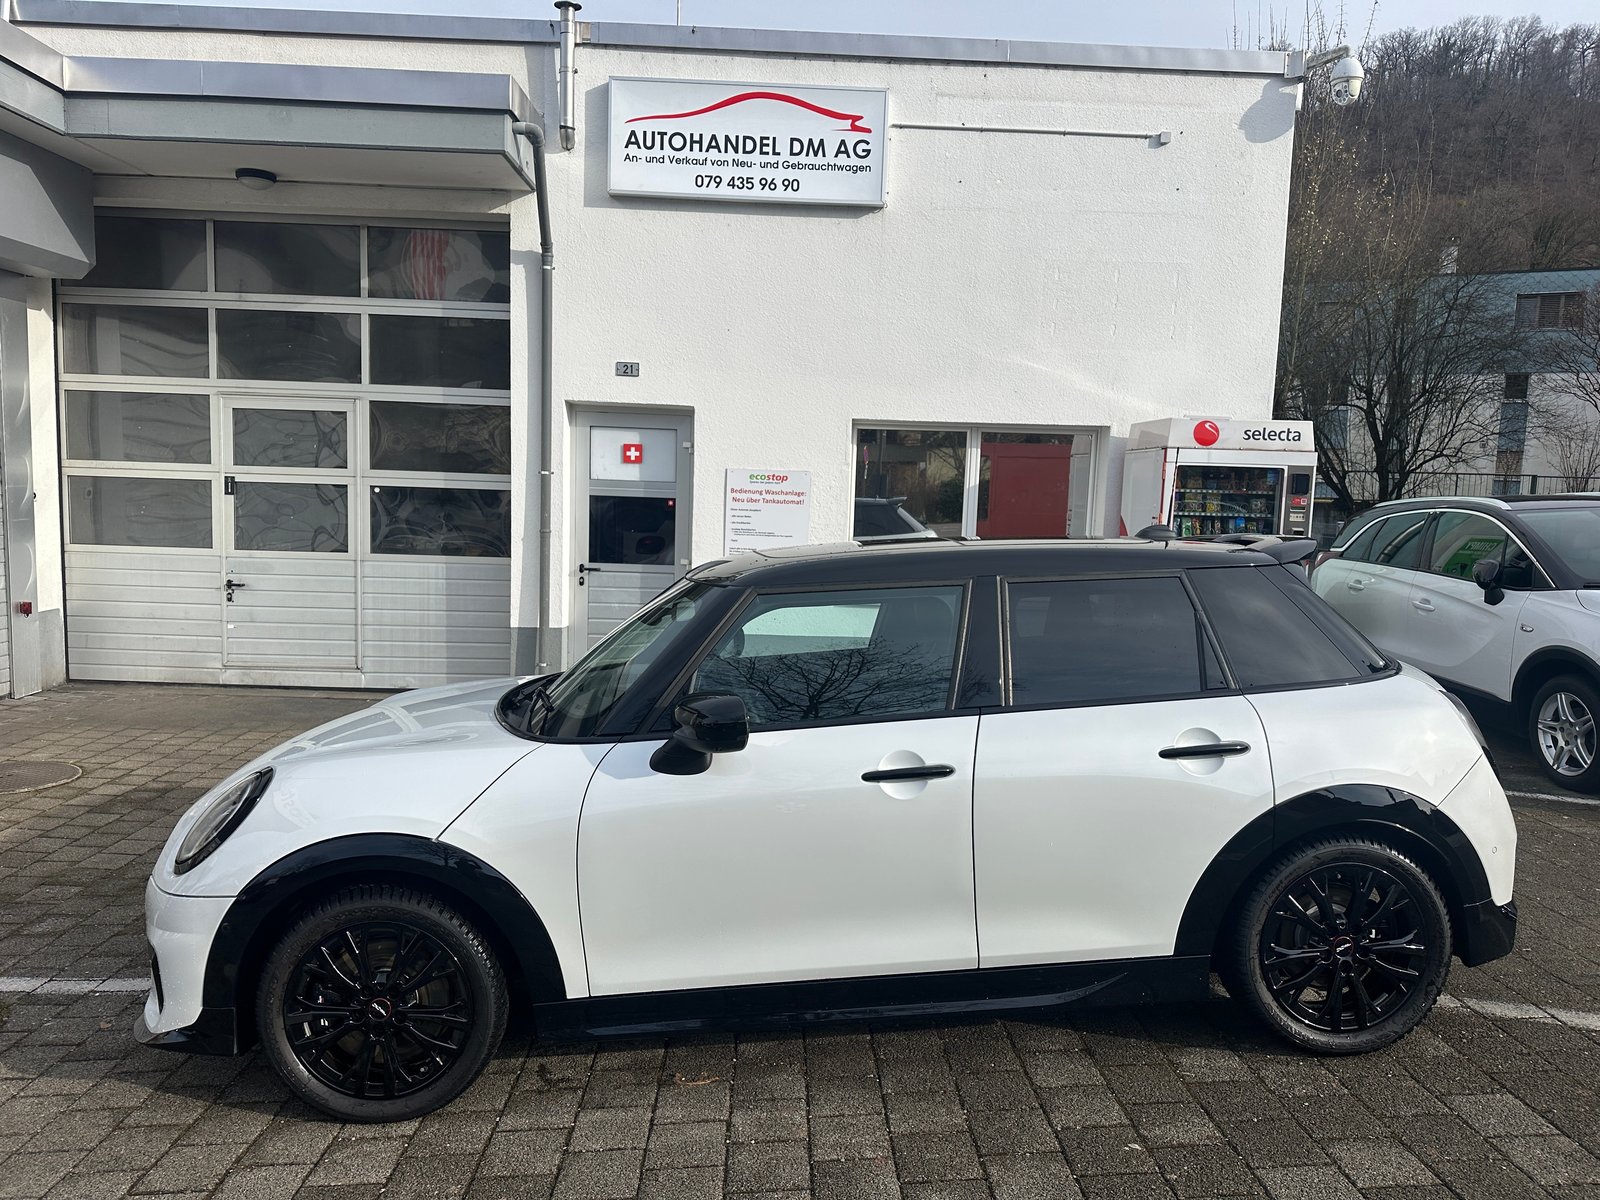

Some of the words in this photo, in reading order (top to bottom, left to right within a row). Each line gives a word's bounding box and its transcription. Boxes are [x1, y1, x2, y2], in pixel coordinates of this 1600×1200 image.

[624, 130, 781, 155] AUTOHANDEL
[789, 137, 827, 157] DM
[834, 139, 872, 159] AG
[624, 153, 642, 163] An-
[645, 155, 665, 164] und
[668, 155, 708, 166] Verkauf
[711, 158, 729, 168] von
[732, 158, 756, 168] Neu-
[759, 160, 779, 169] und
[782, 160, 872, 174] Gebrauchtwagen
[695, 174, 722, 188] 079
[727, 176, 754, 190] 435
[759, 177, 777, 191] 96
[782, 178, 800, 192] 90
[623, 364, 633, 374] 21
[1243, 427, 1301, 442] selecta
[749, 473, 788, 483] ecostop
[730, 488, 763, 496] Bedienung
[764, 489, 807, 497] Waschanlage:
